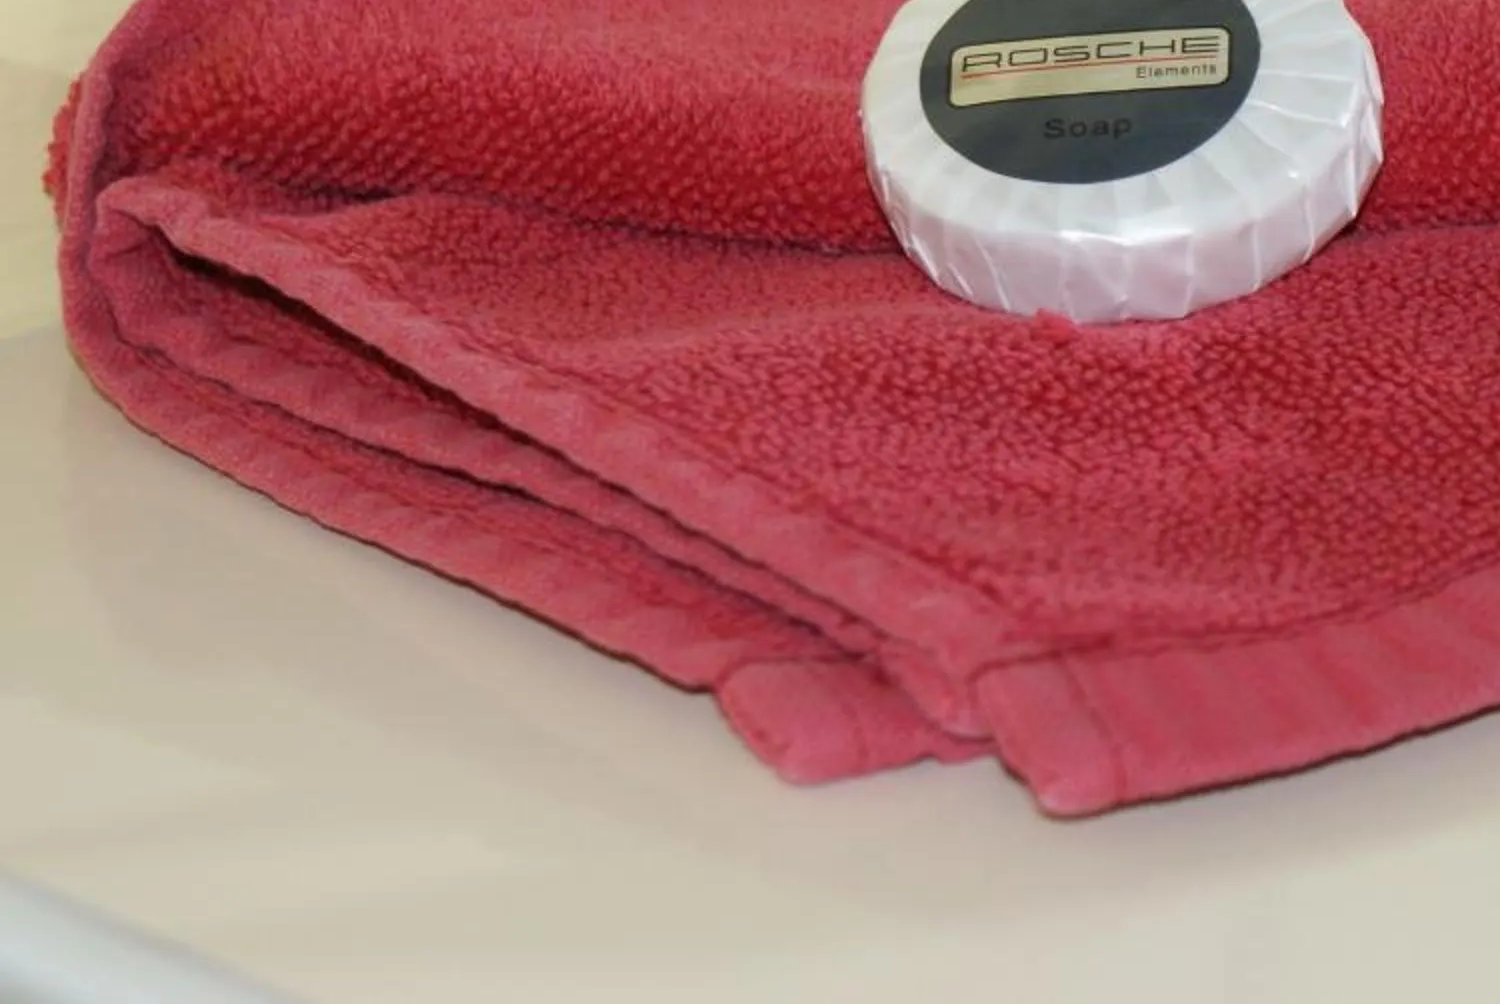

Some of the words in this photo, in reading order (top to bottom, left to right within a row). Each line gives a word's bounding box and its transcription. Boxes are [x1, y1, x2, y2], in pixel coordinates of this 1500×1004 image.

[962, 37, 1219, 72] ROSCHE
[1136, 64, 1217, 79] Elements
[1044, 118, 1132, 140] Soap
